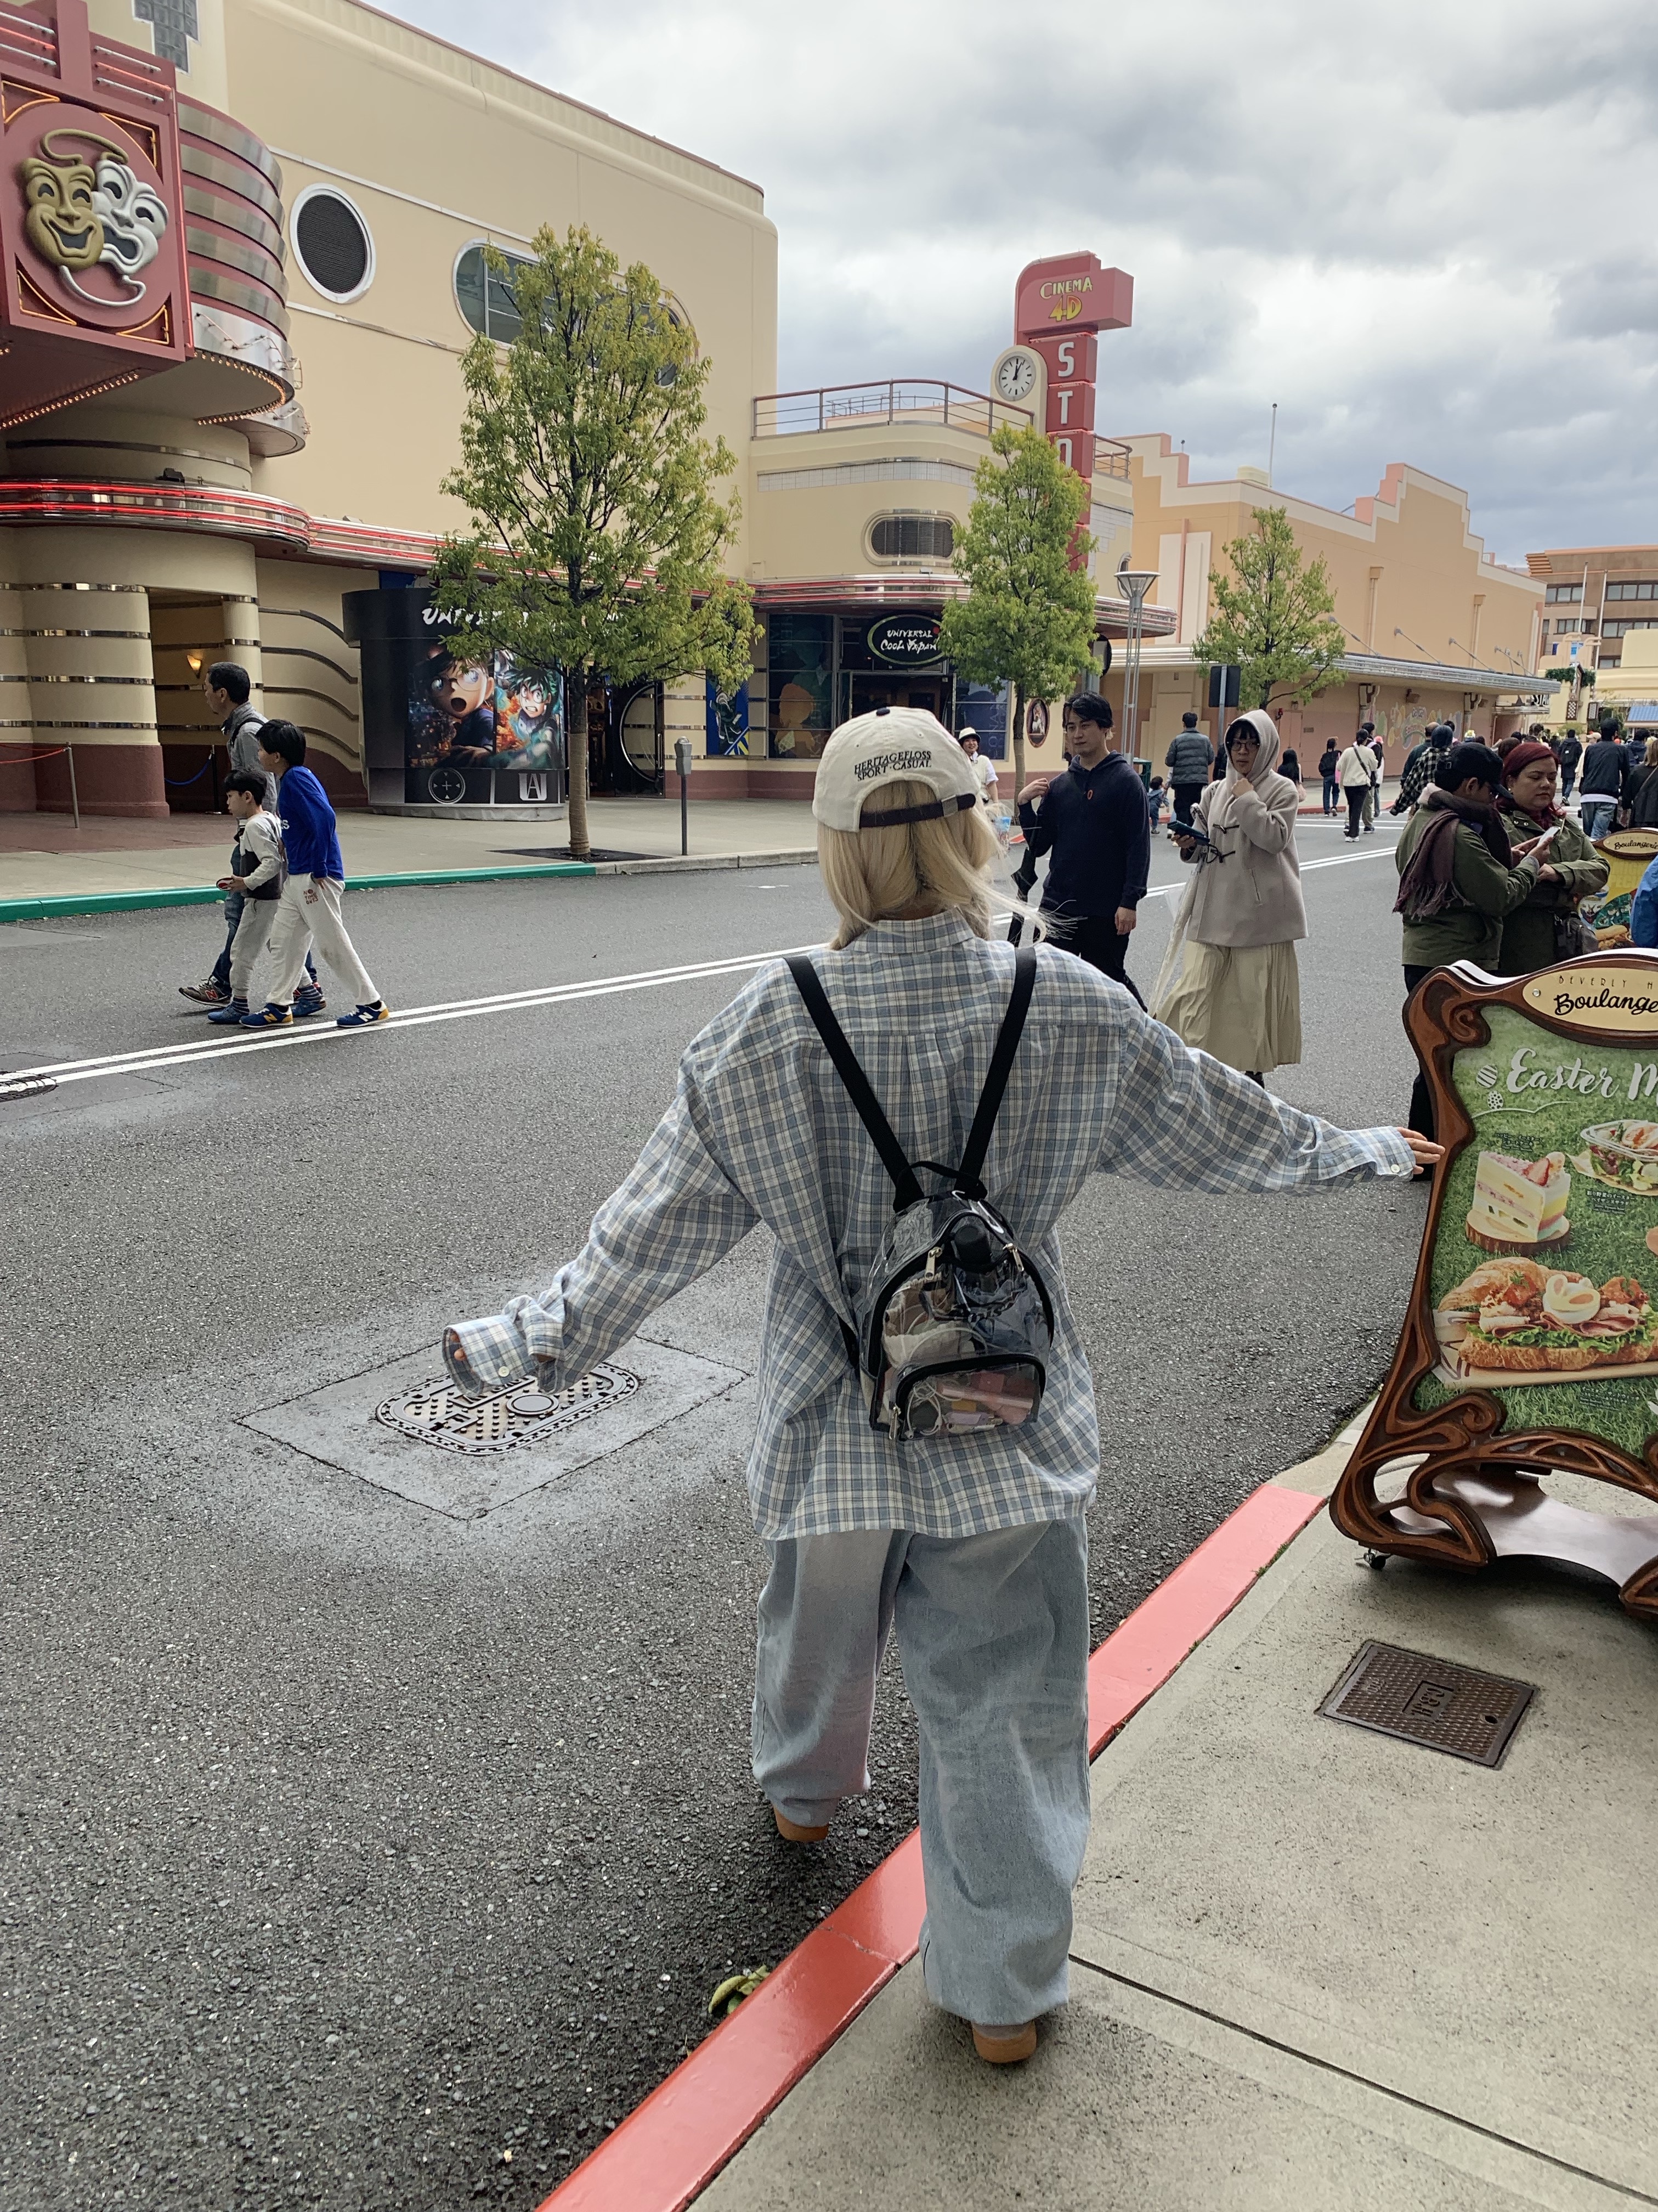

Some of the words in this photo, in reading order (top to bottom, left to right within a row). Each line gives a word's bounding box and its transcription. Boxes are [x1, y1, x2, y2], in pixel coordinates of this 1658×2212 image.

[1040, 276, 1093, 300] CINEMA
[1049, 295, 1082, 323] 4-D
[887, 629, 933, 637] UNIVERSAL
[855, 751, 932, 775] HERITAGEFLOSS
[857, 765, 889, 782] SPORT
[893, 759, 932, 770] CASUAL
[1559, 975, 1627, 988] BEVERLY
[1506, 1048, 1619, 1098] Easter
